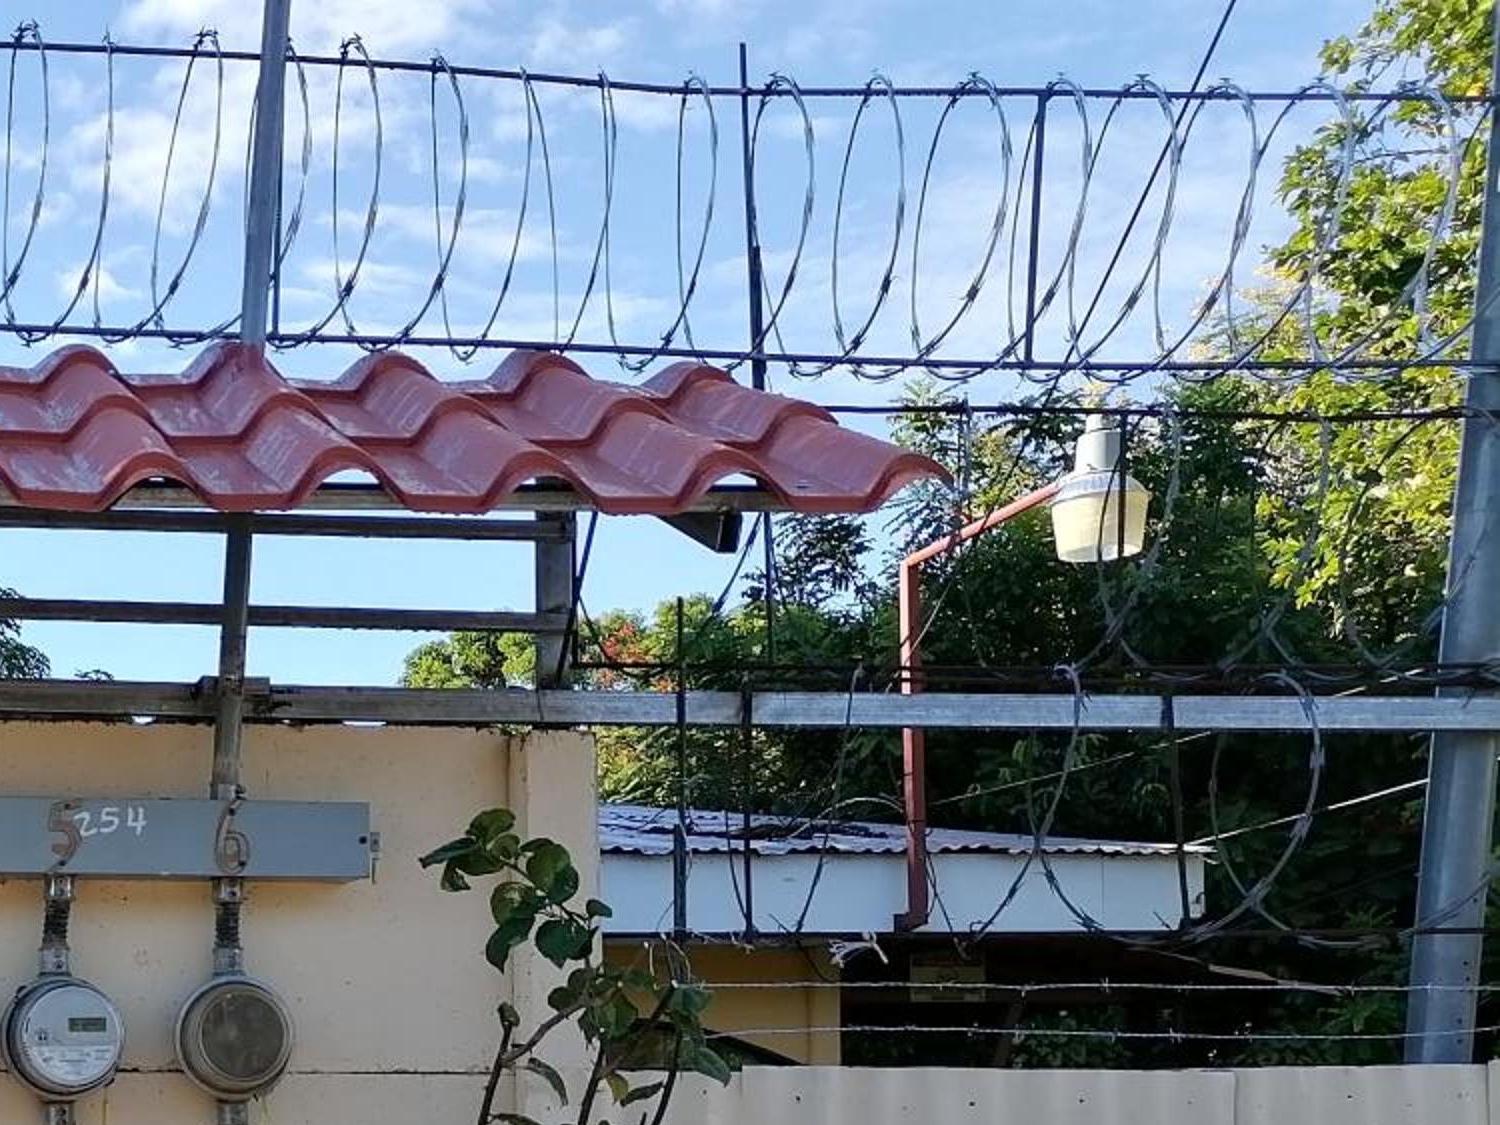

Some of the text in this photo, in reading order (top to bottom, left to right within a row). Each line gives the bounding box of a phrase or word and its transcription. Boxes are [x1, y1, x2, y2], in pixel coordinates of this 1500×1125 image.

[48, 798, 83, 872] 5
[74, 807, 146, 839] 254
[214, 797, 250, 874] 6
